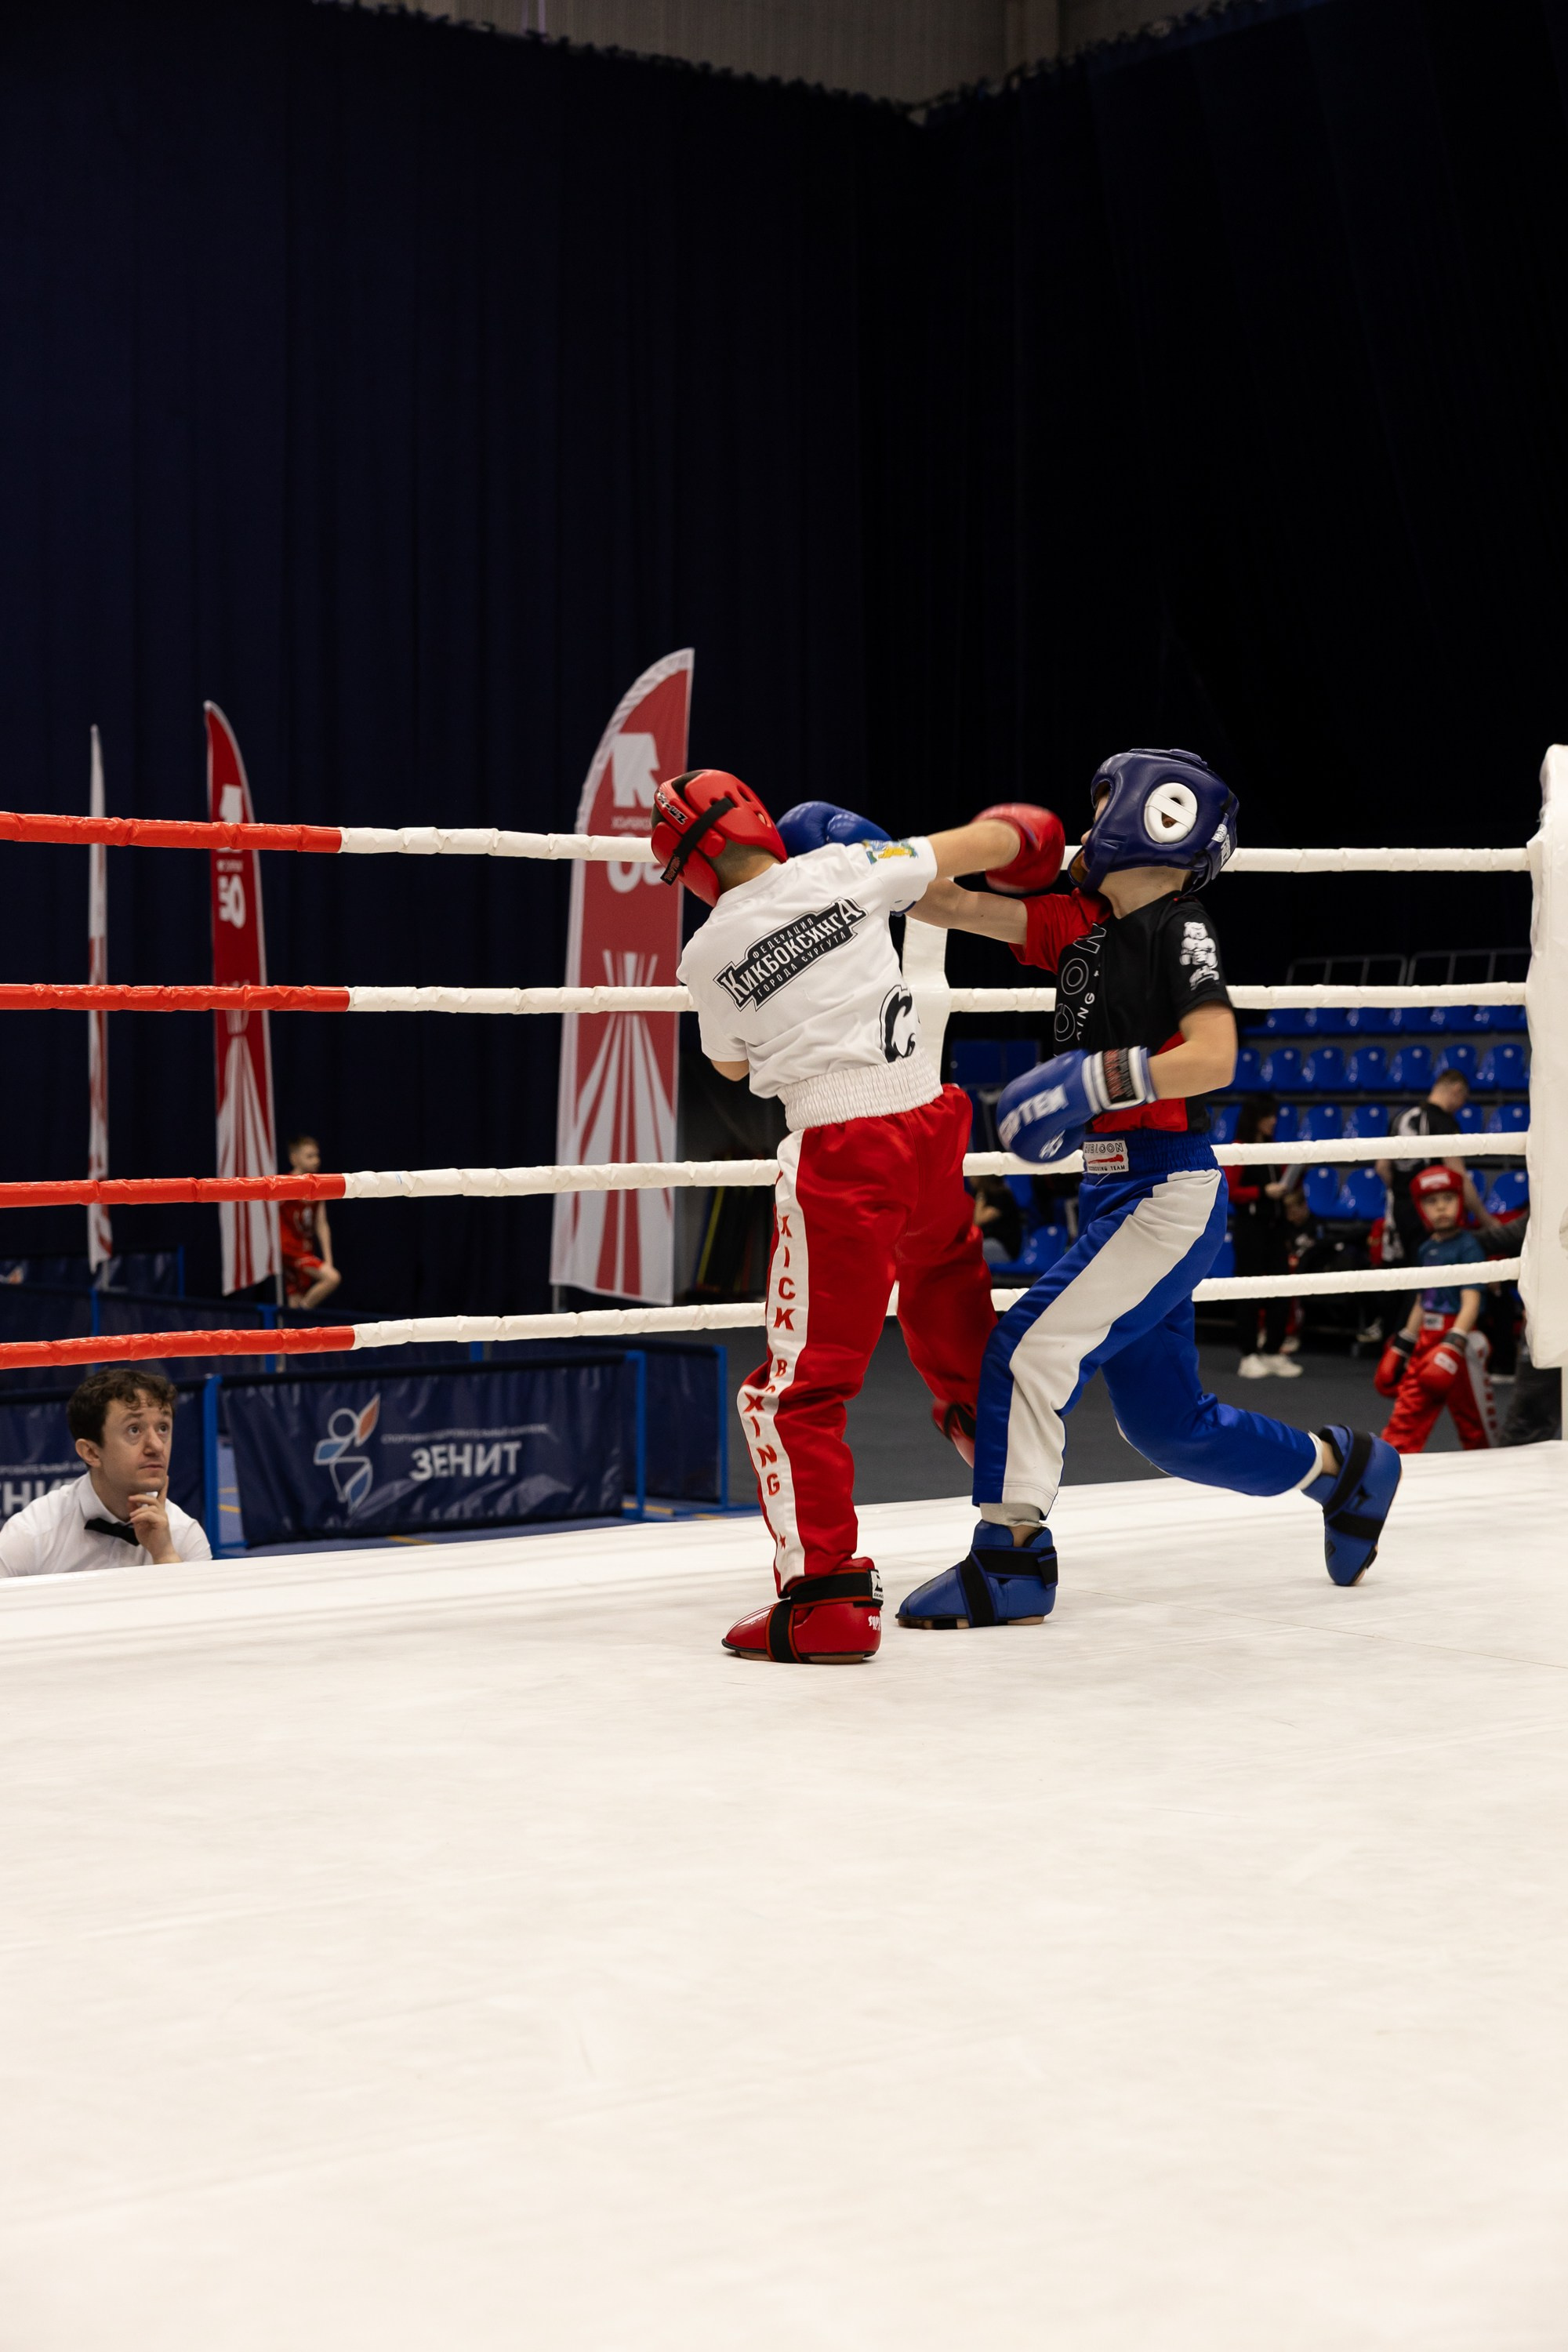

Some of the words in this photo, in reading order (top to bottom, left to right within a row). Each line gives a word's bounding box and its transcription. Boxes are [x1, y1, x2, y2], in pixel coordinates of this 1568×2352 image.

[752, 916, 813, 958] ФЕДЕРАЦИЯ
[757, 963, 798, 997] ГОРОДА
[800, 931, 847, 964] СУРГУТА
[409, 1441, 521, 1483] ЗЕНИТ
